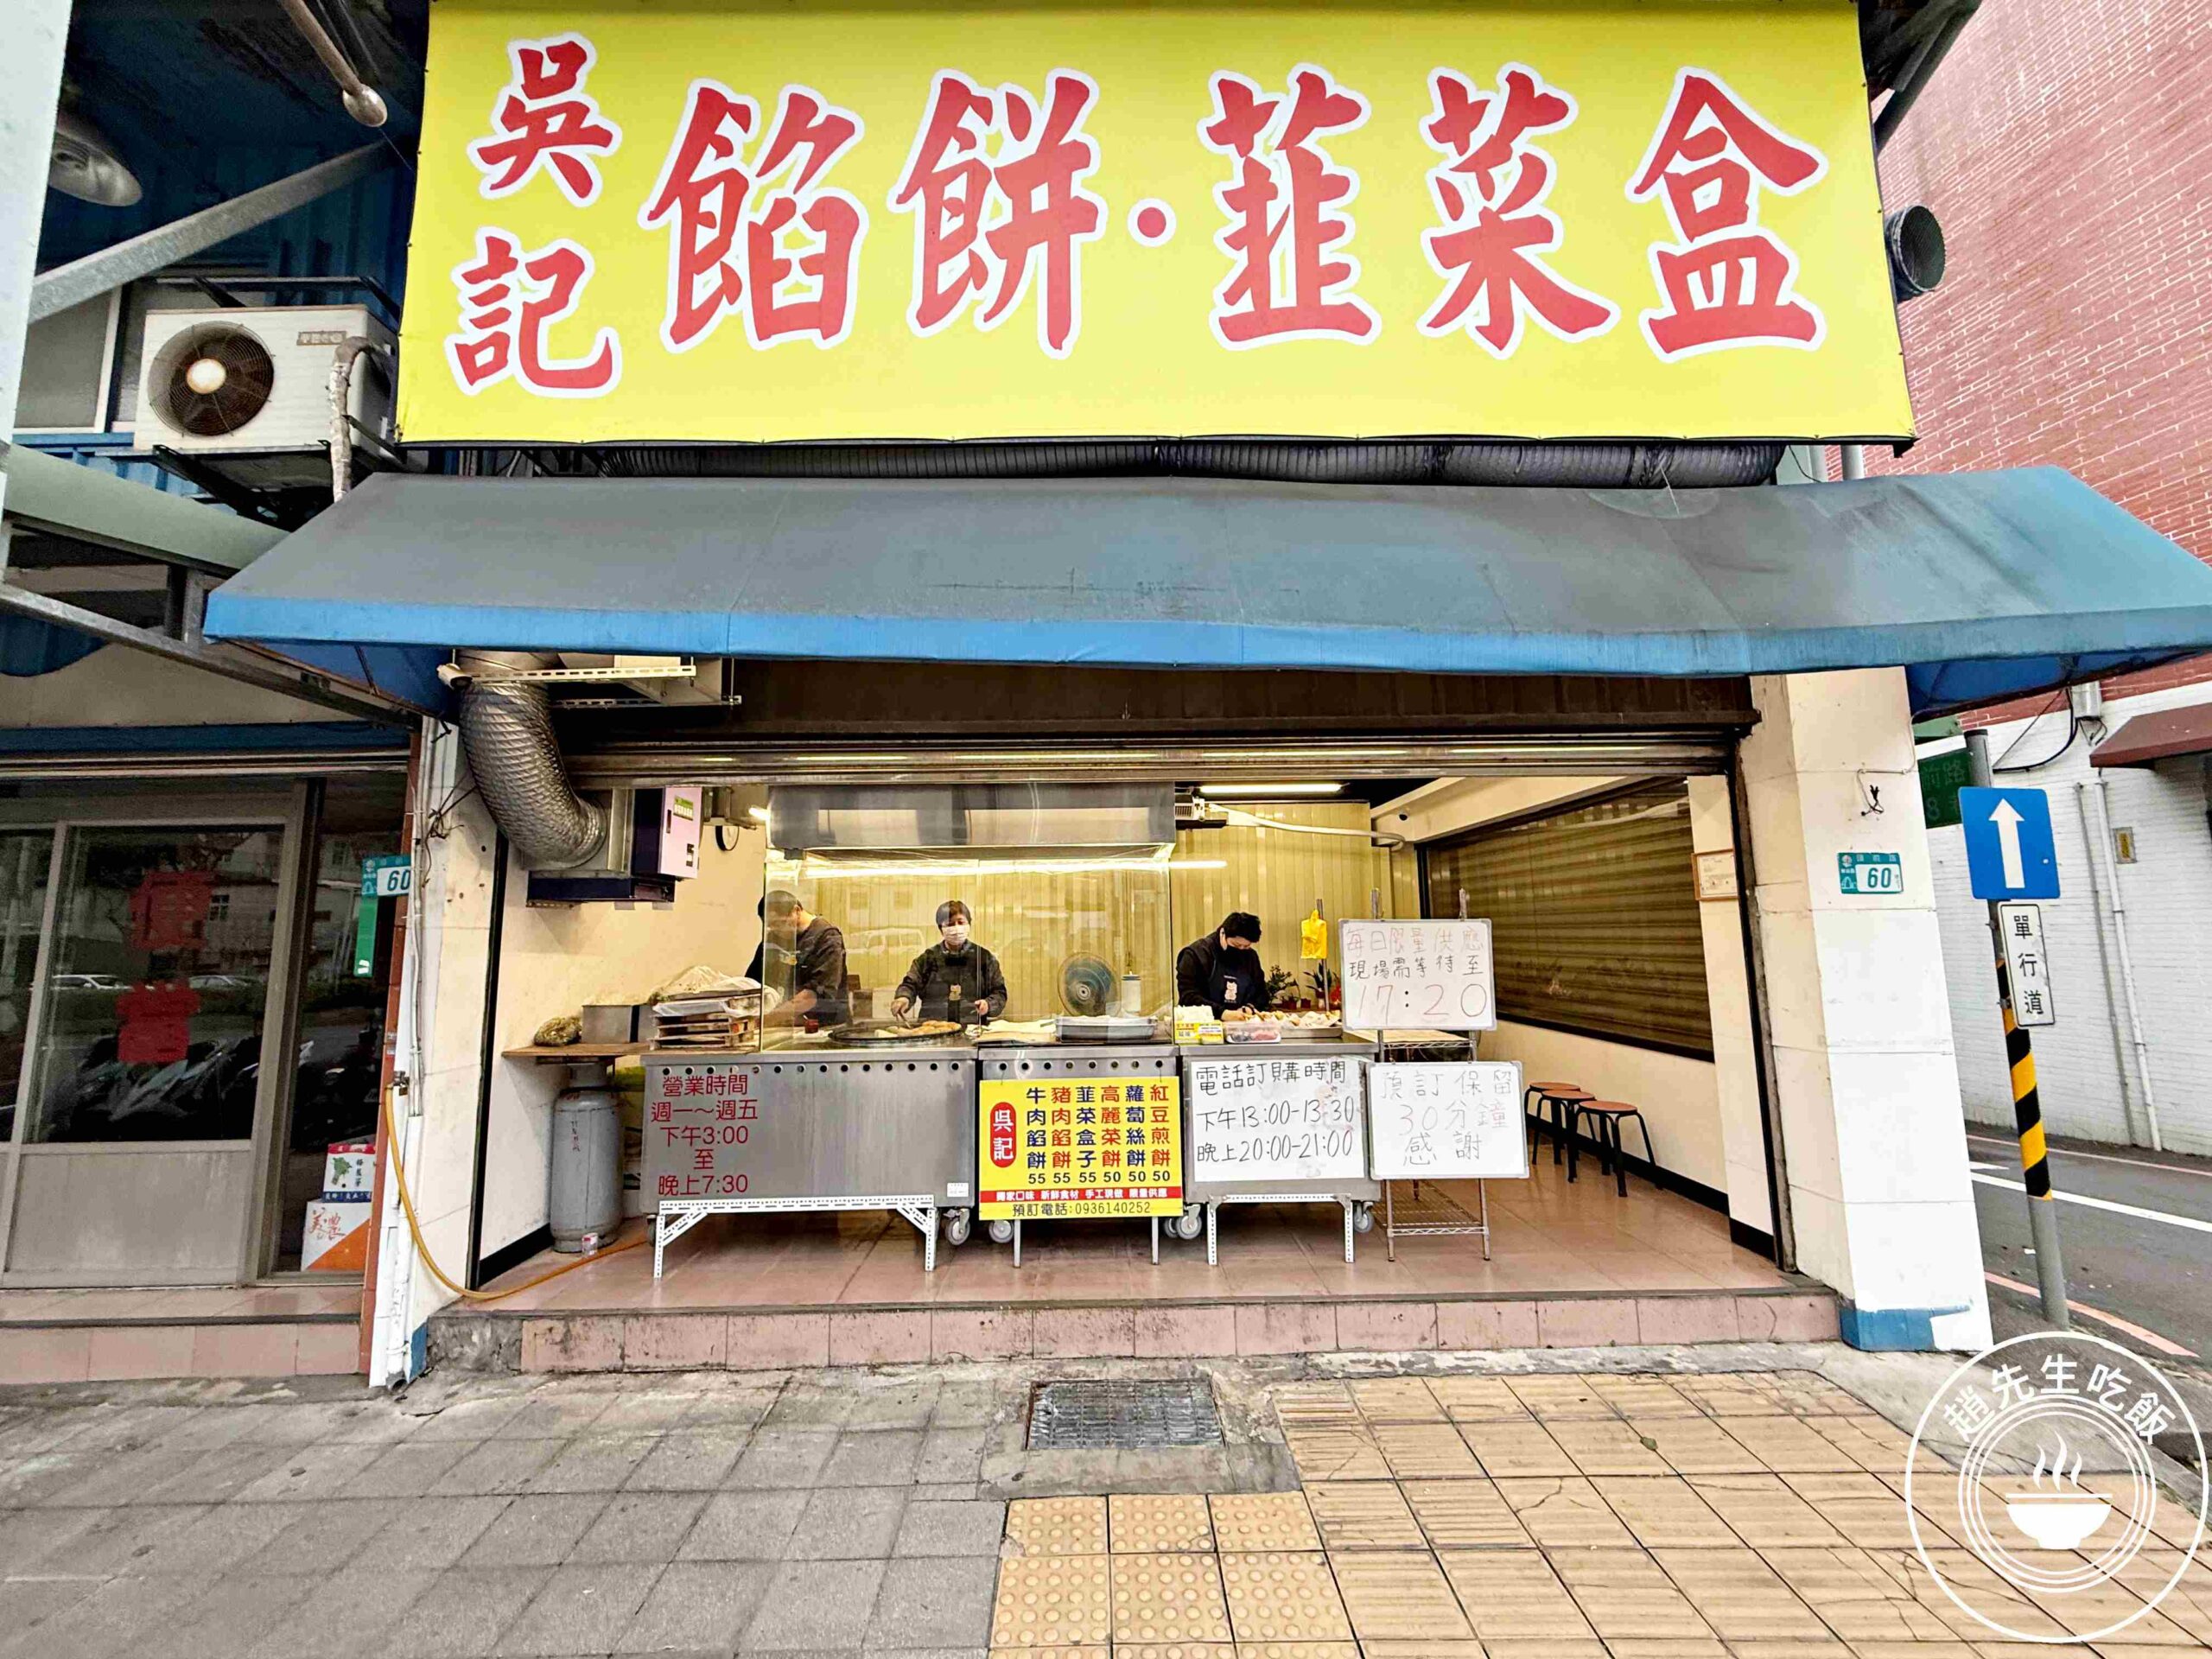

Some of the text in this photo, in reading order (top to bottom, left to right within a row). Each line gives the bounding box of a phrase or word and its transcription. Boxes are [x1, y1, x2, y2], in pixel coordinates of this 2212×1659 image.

[449, 36, 618, 394] 吳記
[386, 869, 410, 892] 60
[1867, 867, 1891, 888] 60
[1346, 925, 1484, 957] 每日限量供應
[1349, 954, 1484, 980] 現場需等待至
[2014, 916, 2044, 1016] 單行道
[662, 1074, 748, 1097] 營業時間
[1196, 1060, 1345, 1096] 電話訂購時間
[1381, 1069, 1512, 1100] 預訂保留
[1026, 1086, 1046, 1169] 牛肉餡餅
[1051, 1086, 1071, 1169] 豬肉餡餅
[1101, 1085, 1122, 1168] 高麗菜餅
[1125, 1085, 1146, 1167] 蘿蔔絲餅
[1149, 1084, 1171, 1167] 紅豆煎餅
[1399, 1100, 1509, 1136] 30分鐘
[659, 1125, 748, 1147] 下午3:00
[1403, 1130, 1483, 1166] 感謝
[693, 1148, 715, 1170] 至
[658, 1174, 748, 1197] 晚上7:30
[1028, 1171, 1170, 1184] 55 55 55 50 50 50
